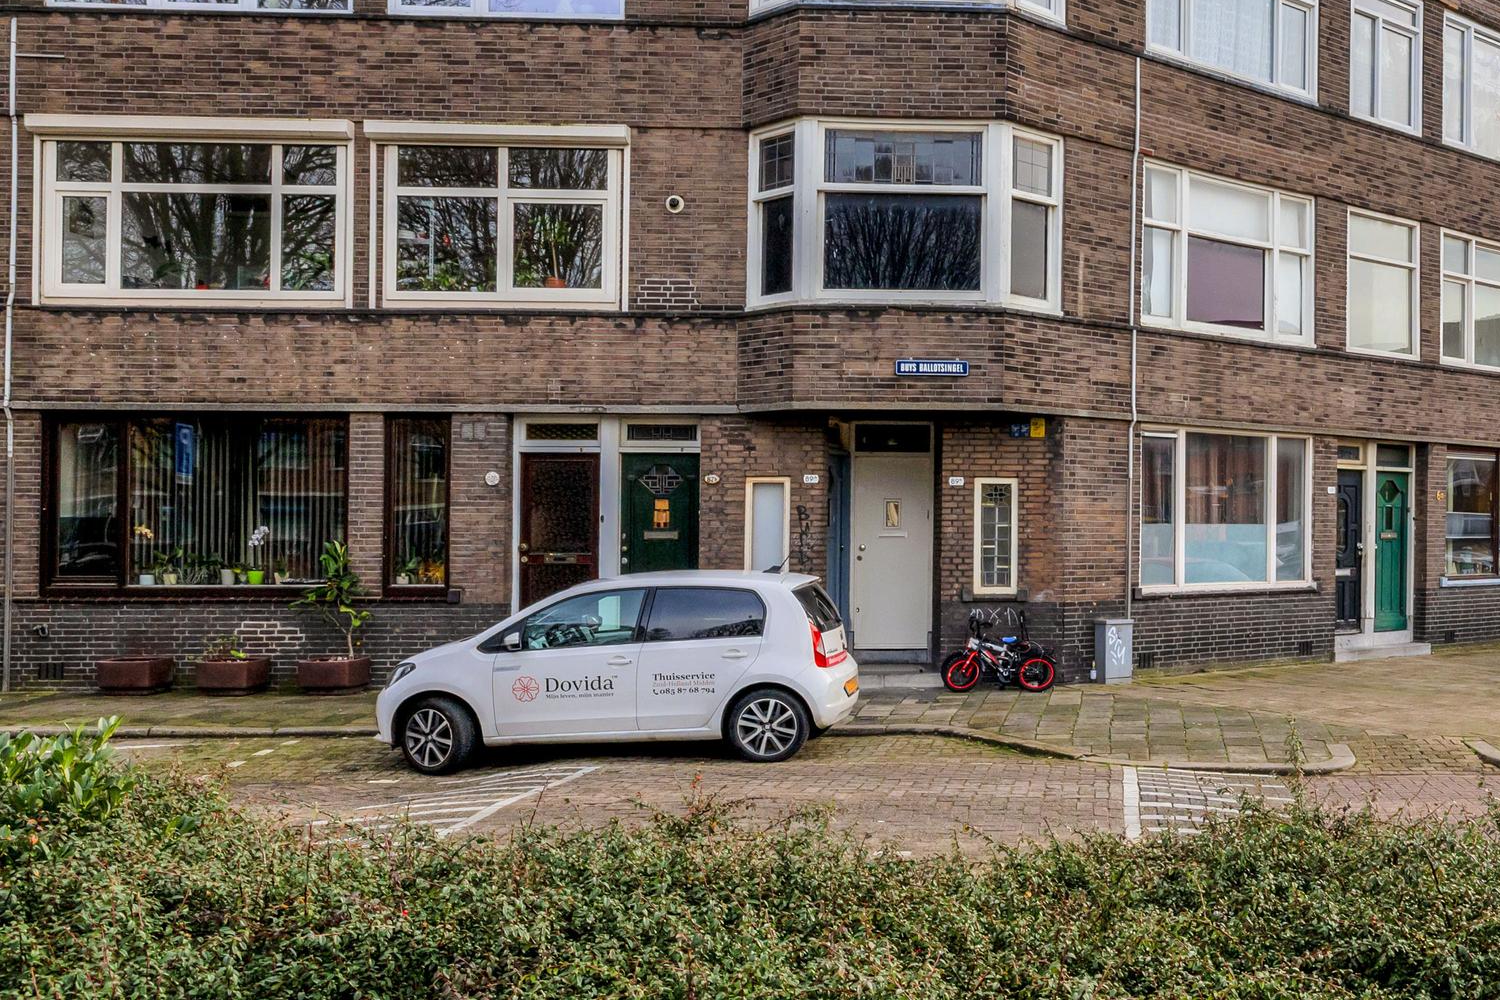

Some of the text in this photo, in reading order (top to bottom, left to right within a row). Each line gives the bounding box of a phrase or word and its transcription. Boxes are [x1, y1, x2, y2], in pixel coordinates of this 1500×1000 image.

[900, 363, 964, 373] BUYS BALLOTSINGEL
[652, 672, 715, 681] Thuisservice
[545, 675, 614, 692] Dovida
